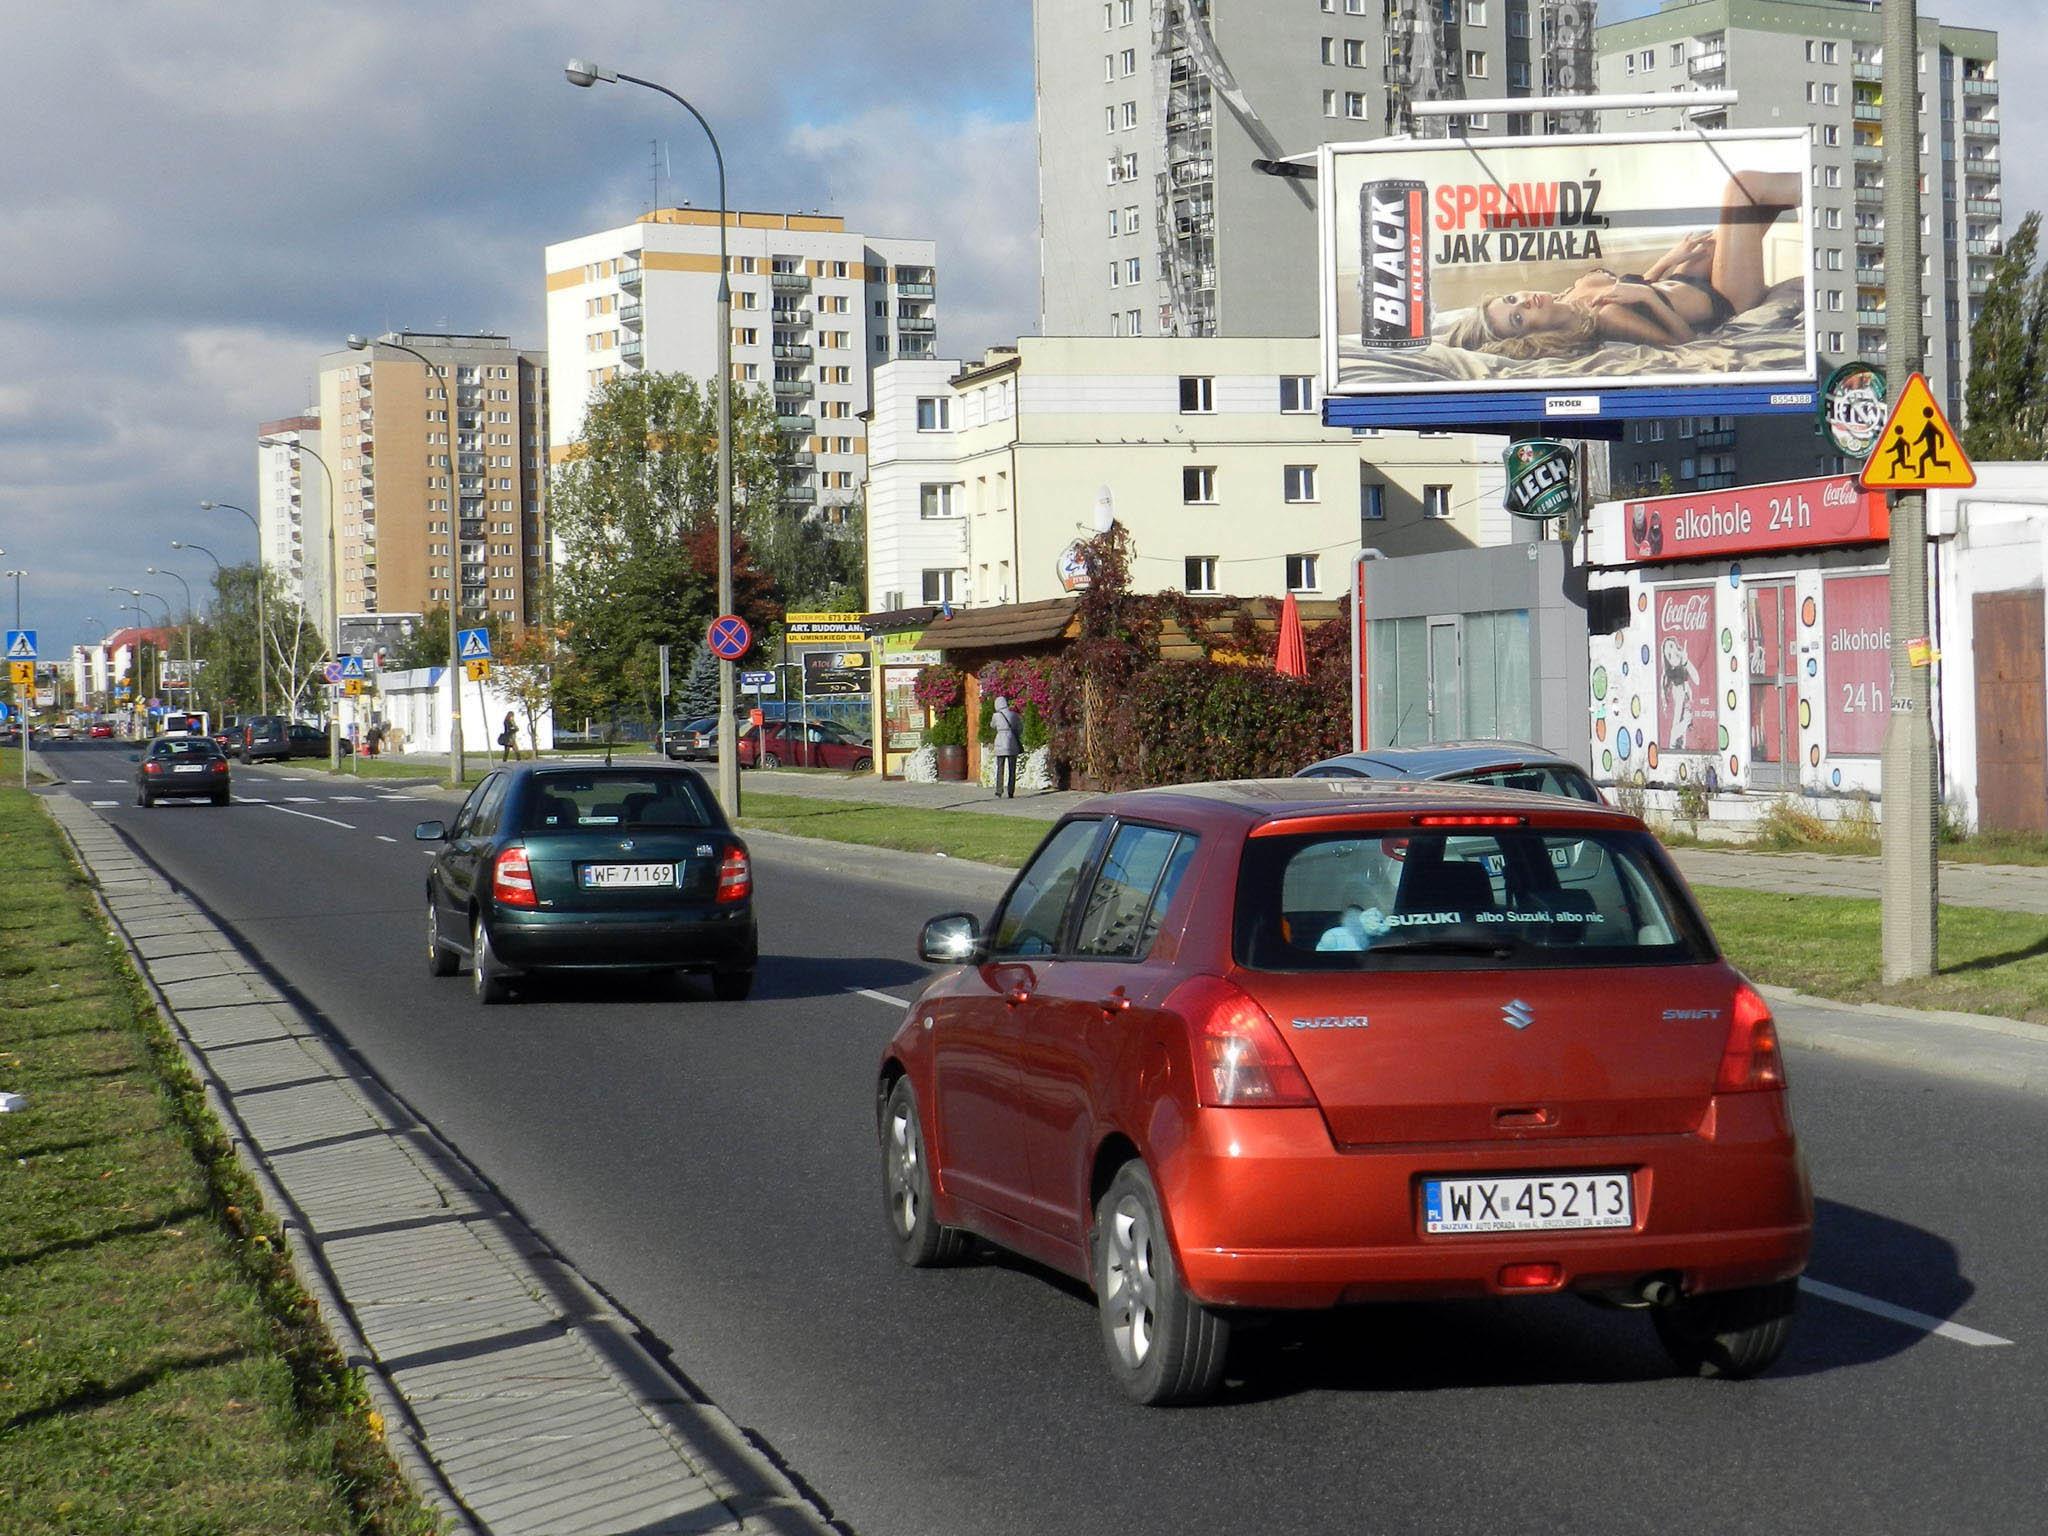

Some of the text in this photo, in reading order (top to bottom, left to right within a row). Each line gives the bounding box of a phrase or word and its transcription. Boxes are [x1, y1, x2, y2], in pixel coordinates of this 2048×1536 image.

[1435, 168, 1610, 231] SPRAWDŹ,
[1435, 229, 1603, 265] JAK DZIAŁA
[1372, 196, 1406, 328] BLACK
[1411, 233, 1424, 303] ENERGY
[1515, 457, 1569, 507] LECH
[1674, 495, 1811, 541] alkohole 24 h
[791, 624, 810, 632] ART.
[1831, 627, 1892, 652] alkohole
[1842, 682, 1883, 713] 24 h
[594, 866, 671, 883] WF 71169
[1389, 911, 1462, 927] SUZUKI
[1475, 911, 1605, 924] albo Suzuki, albo nic
[1291, 1016, 1369, 1029] SUZUKI
[1662, 1009, 1721, 1020] SWIFT
[1449, 1179, 1624, 1221] WX 45213
[1428, 1209, 1441, 1220] PL
[1440, 1222, 1473, 1230] SUZUKI
